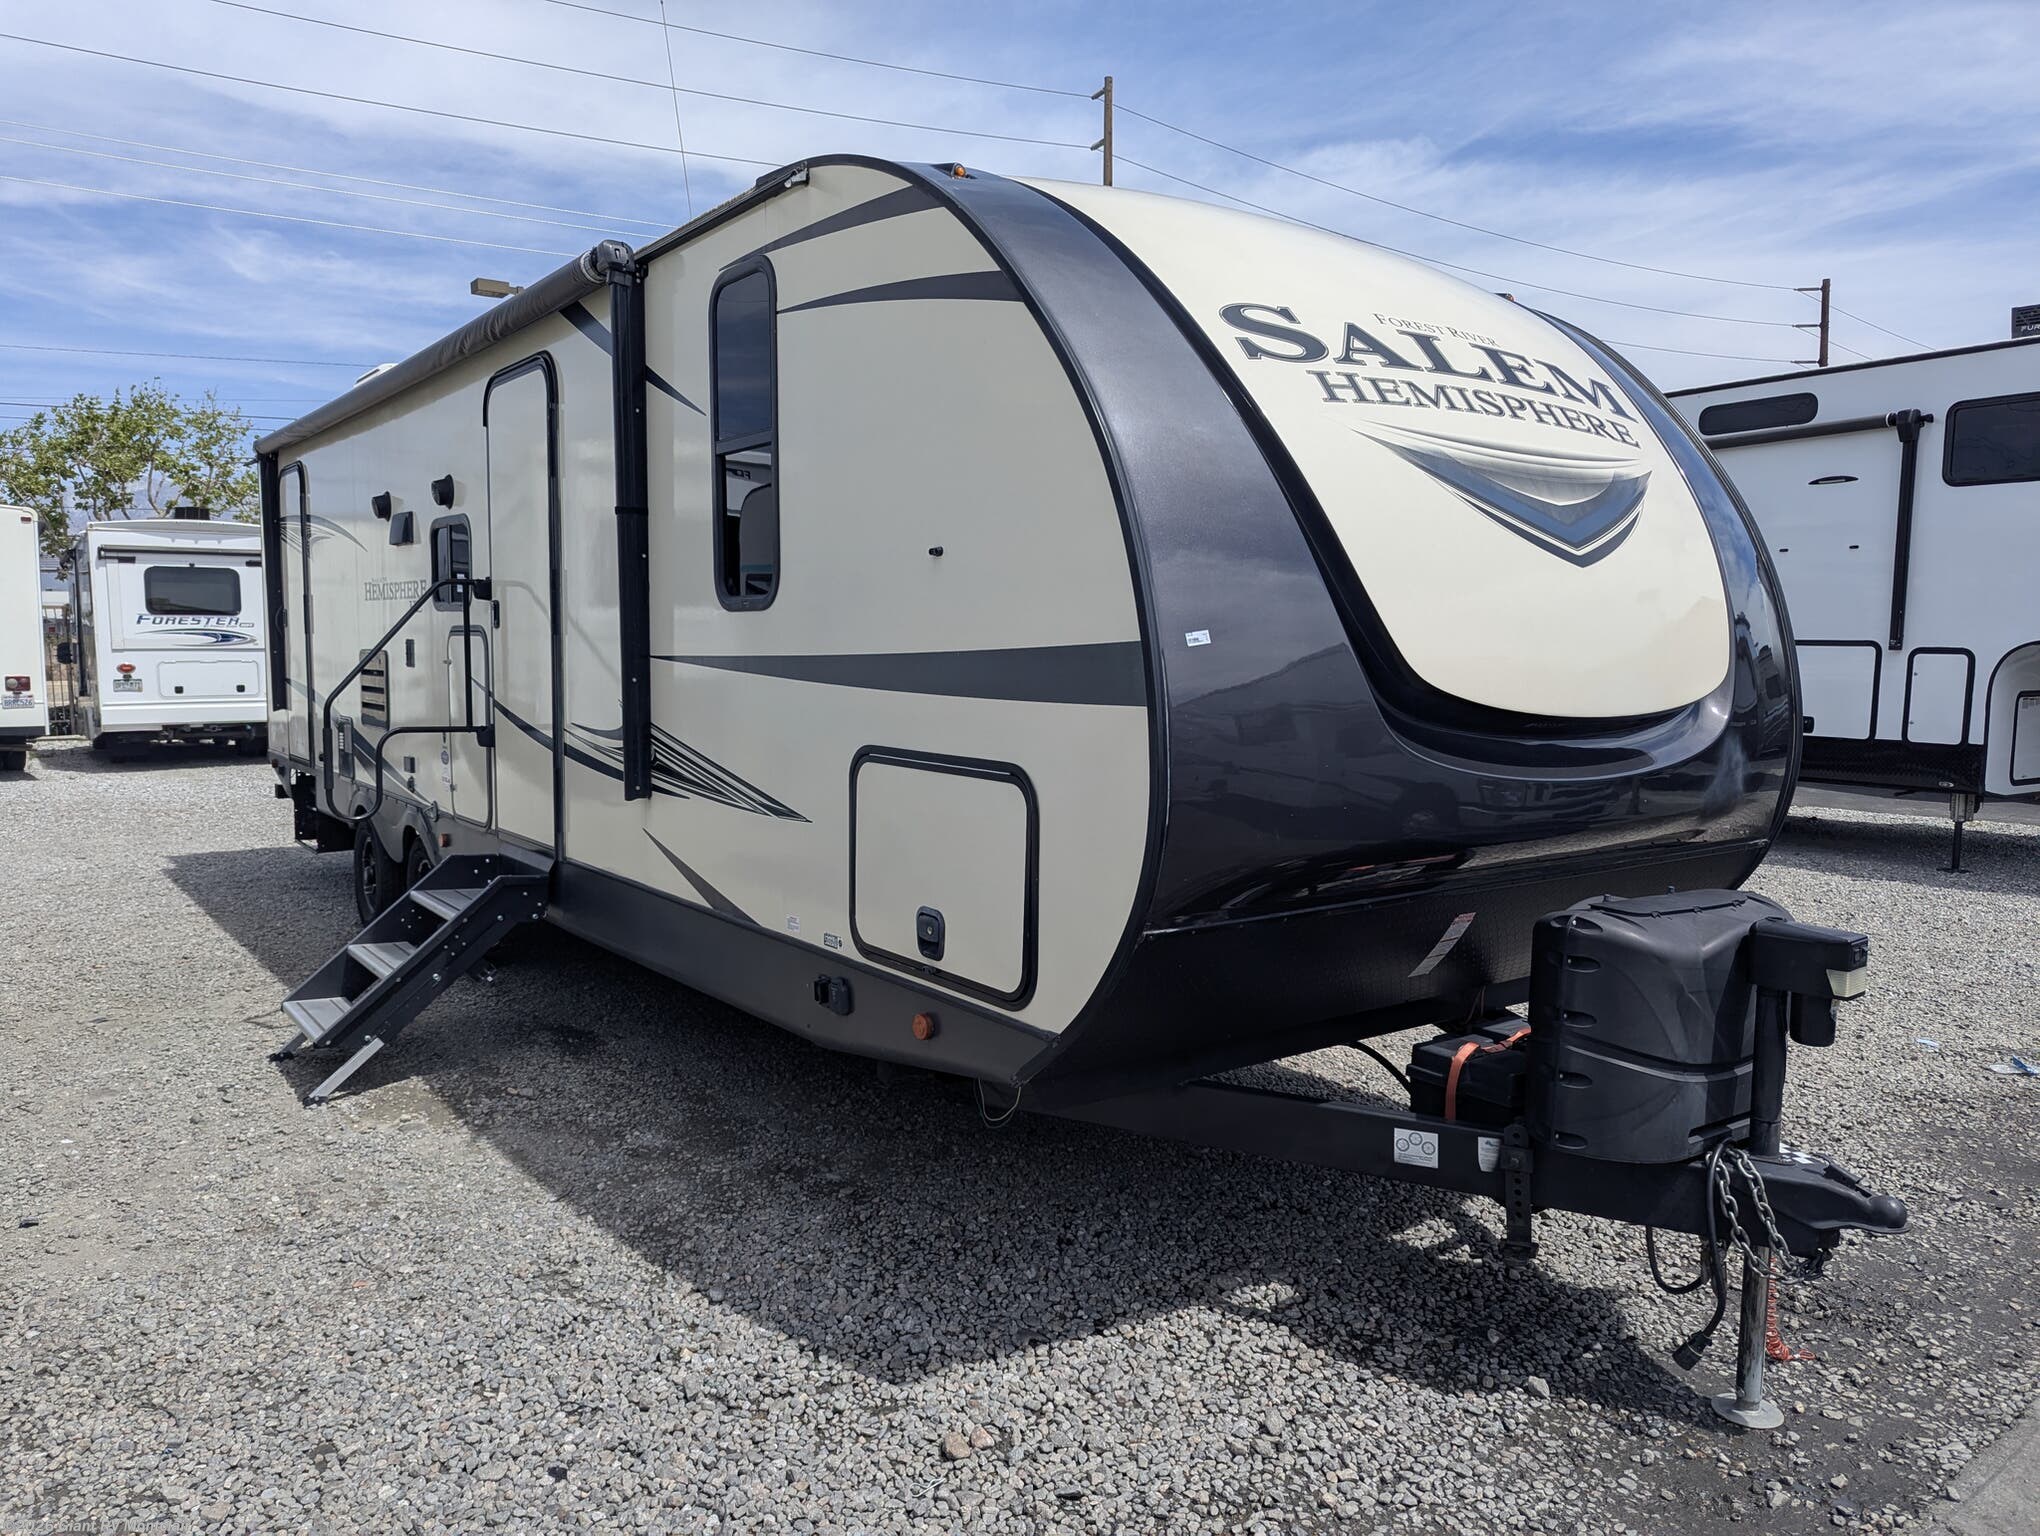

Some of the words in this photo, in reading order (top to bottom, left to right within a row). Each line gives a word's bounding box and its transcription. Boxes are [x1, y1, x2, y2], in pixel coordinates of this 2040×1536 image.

[1372, 312, 1445, 336] FOREST
[1445, 326, 1499, 347] RIVER
[1218, 302, 1639, 423] SALEM
[1306, 369, 1641, 449] HEMISPHERE
[136, 614, 240, 626] FORESTER
